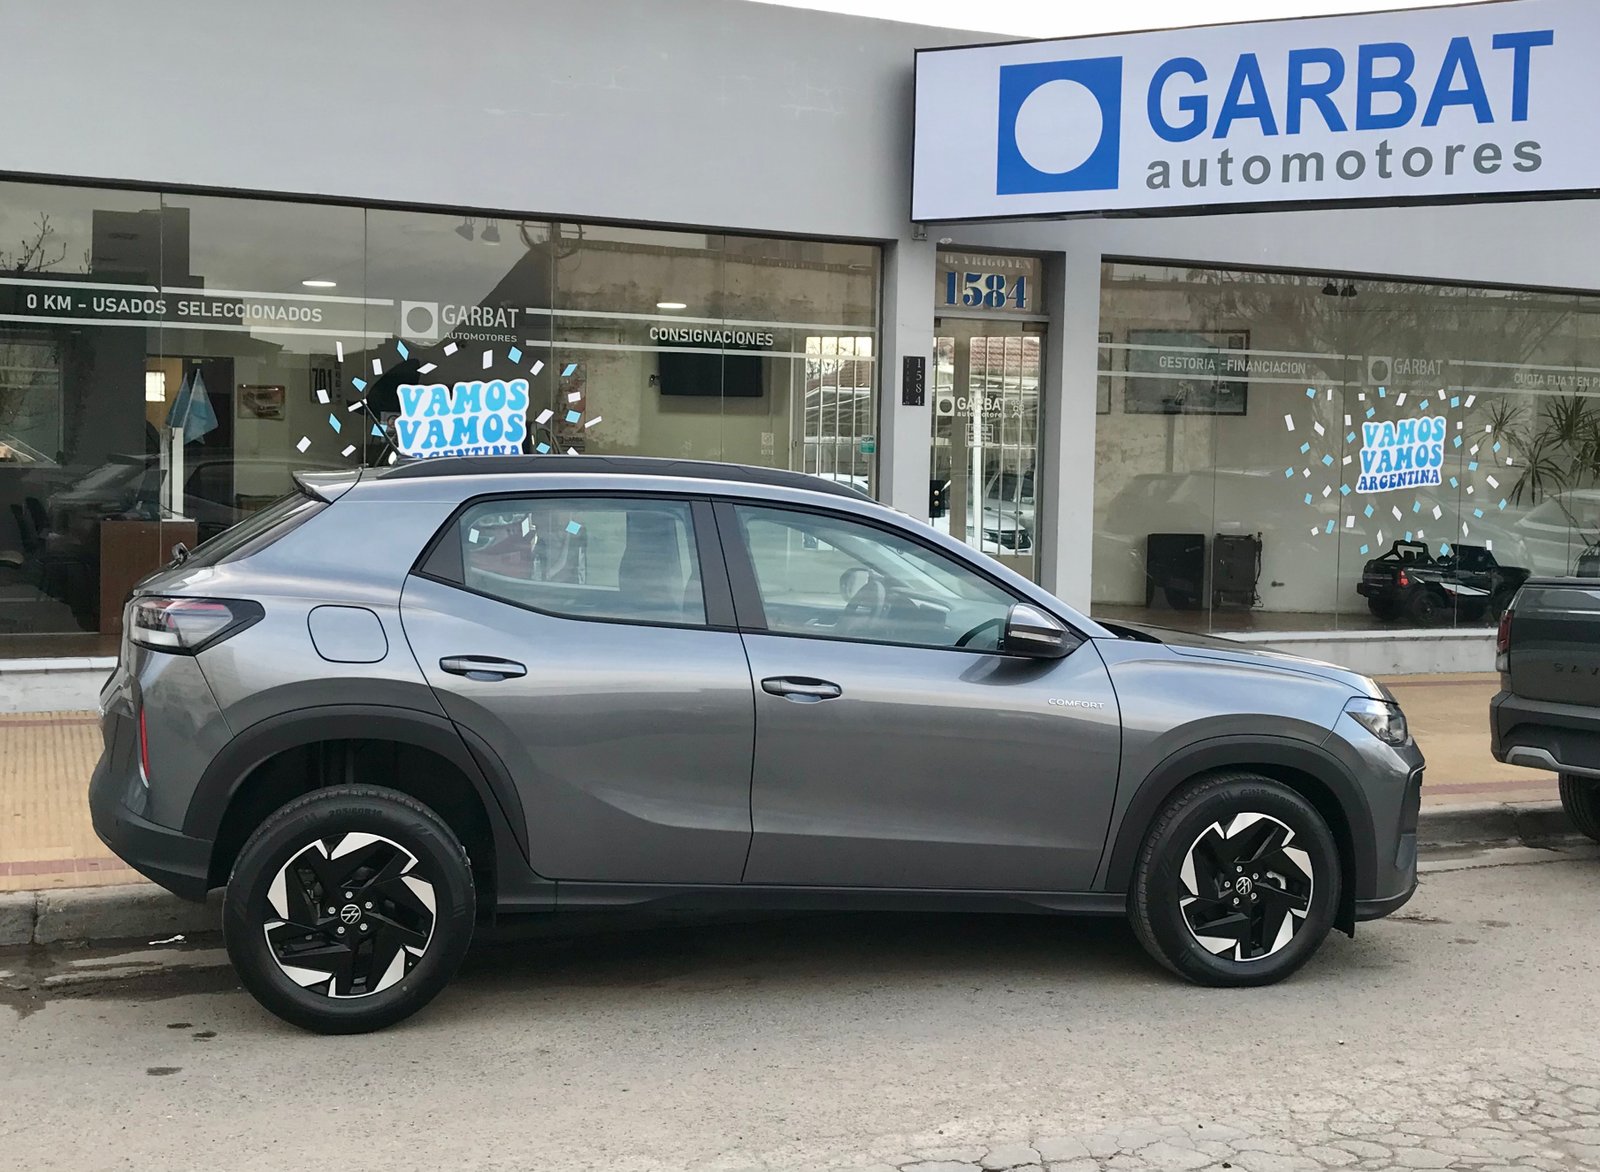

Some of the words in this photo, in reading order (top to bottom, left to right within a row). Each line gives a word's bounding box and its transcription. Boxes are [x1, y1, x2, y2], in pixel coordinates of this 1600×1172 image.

[1147, 29, 1554, 142] GARBAT
[1146, 139, 1542, 189] automotores
[945, 271, 1027, 308] 1584
[27, 294, 37, 309] 0
[44, 294, 71, 311] KM
[93, 297, 167, 314] USADOS
[177, 301, 322, 322] SELECCIONADOS
[442, 304, 519, 328] GARBAT
[444, 332, 517, 343] AUTOMOTORES
[649, 327, 774, 346] CONSIGNACIONES
[1159, 355, 1215, 370] GESTORIA
[1394, 358, 1443, 375] GARBAT
[400, 382, 526, 417] VAMOS
[398, 413, 524, 450] VAMOS
[1364, 418, 1444, 449] VAMOS
[1361, 444, 1442, 474] VAMOS
[1358, 469, 1440, 490] ARGENTINA
[1048, 698, 1104, 709] COMFORT
